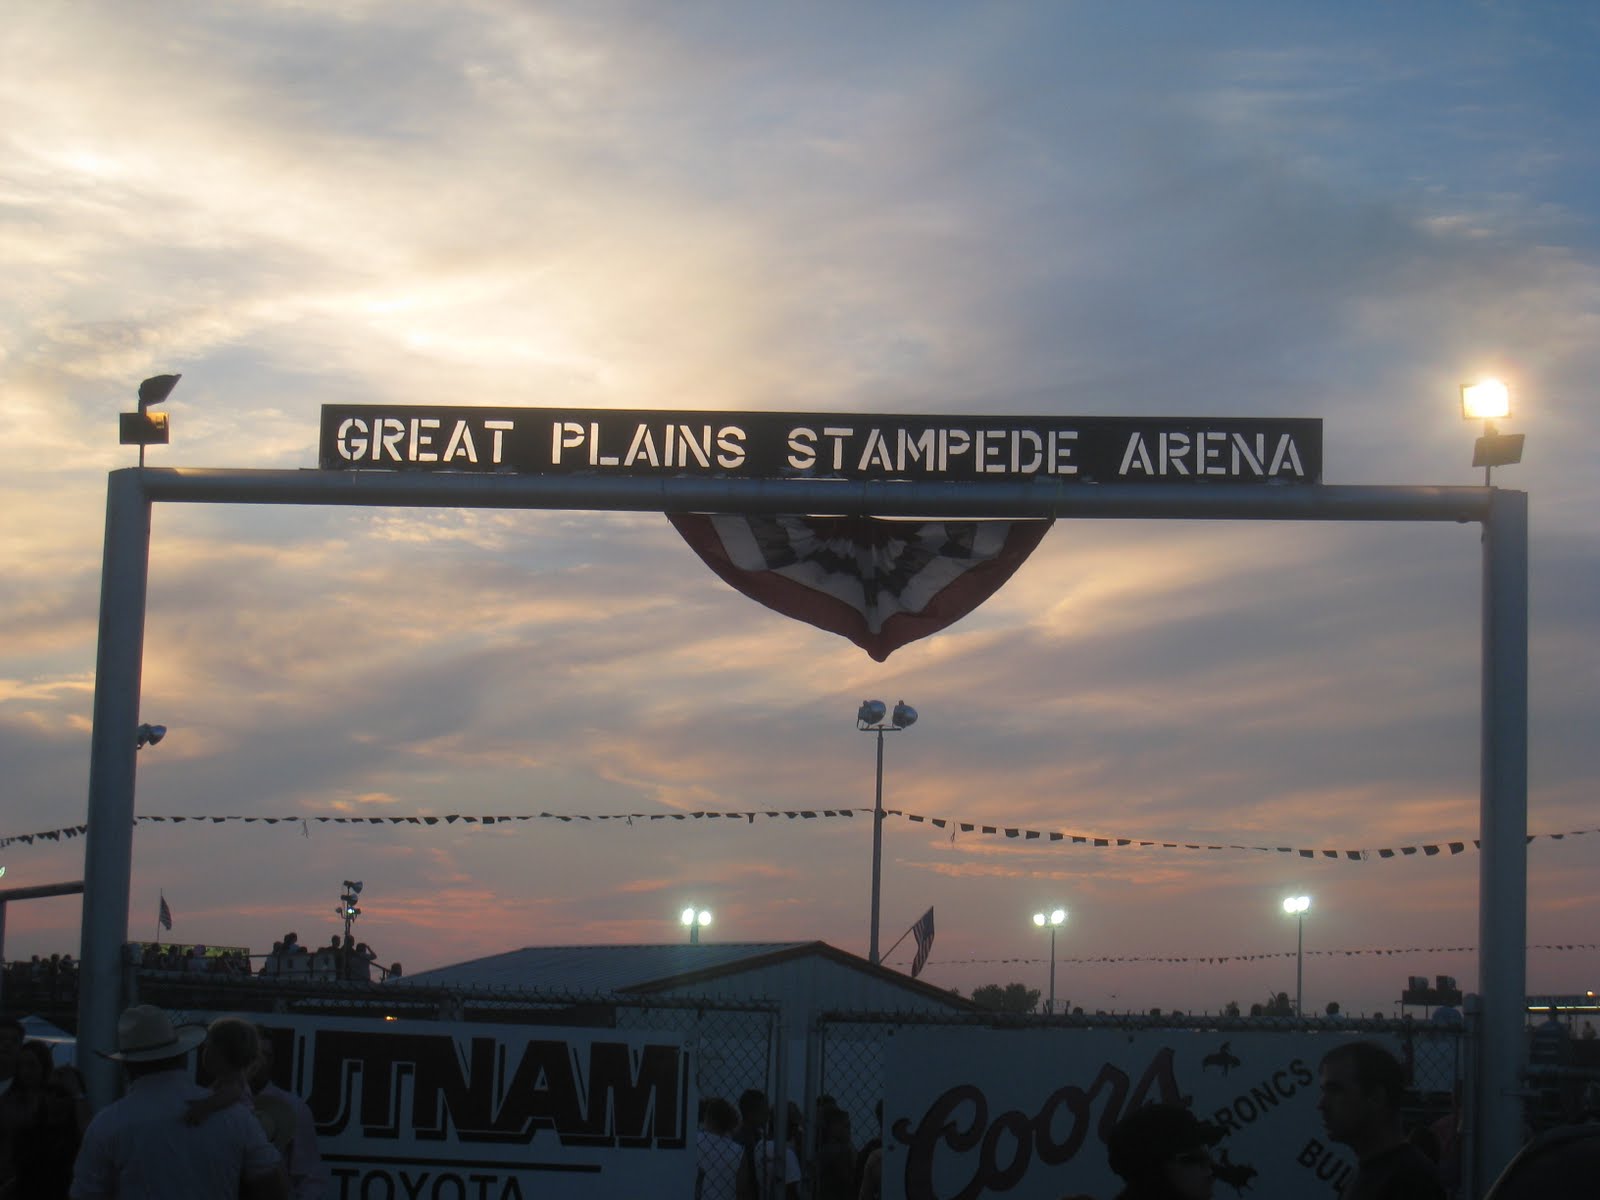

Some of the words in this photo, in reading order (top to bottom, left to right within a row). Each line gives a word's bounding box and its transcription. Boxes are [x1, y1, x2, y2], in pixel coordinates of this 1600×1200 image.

[337, 418, 514, 463] GREAT
[552, 422, 746, 468] PLAINS
[788, 428, 1077, 473] STAMPEDE
[1119, 433, 1303, 475] ARENA
[197, 1026, 692, 1150] UTNAM
[1203, 1059, 1313, 1138] RONCS
[330, 1168, 524, 1200] TOYOTA
